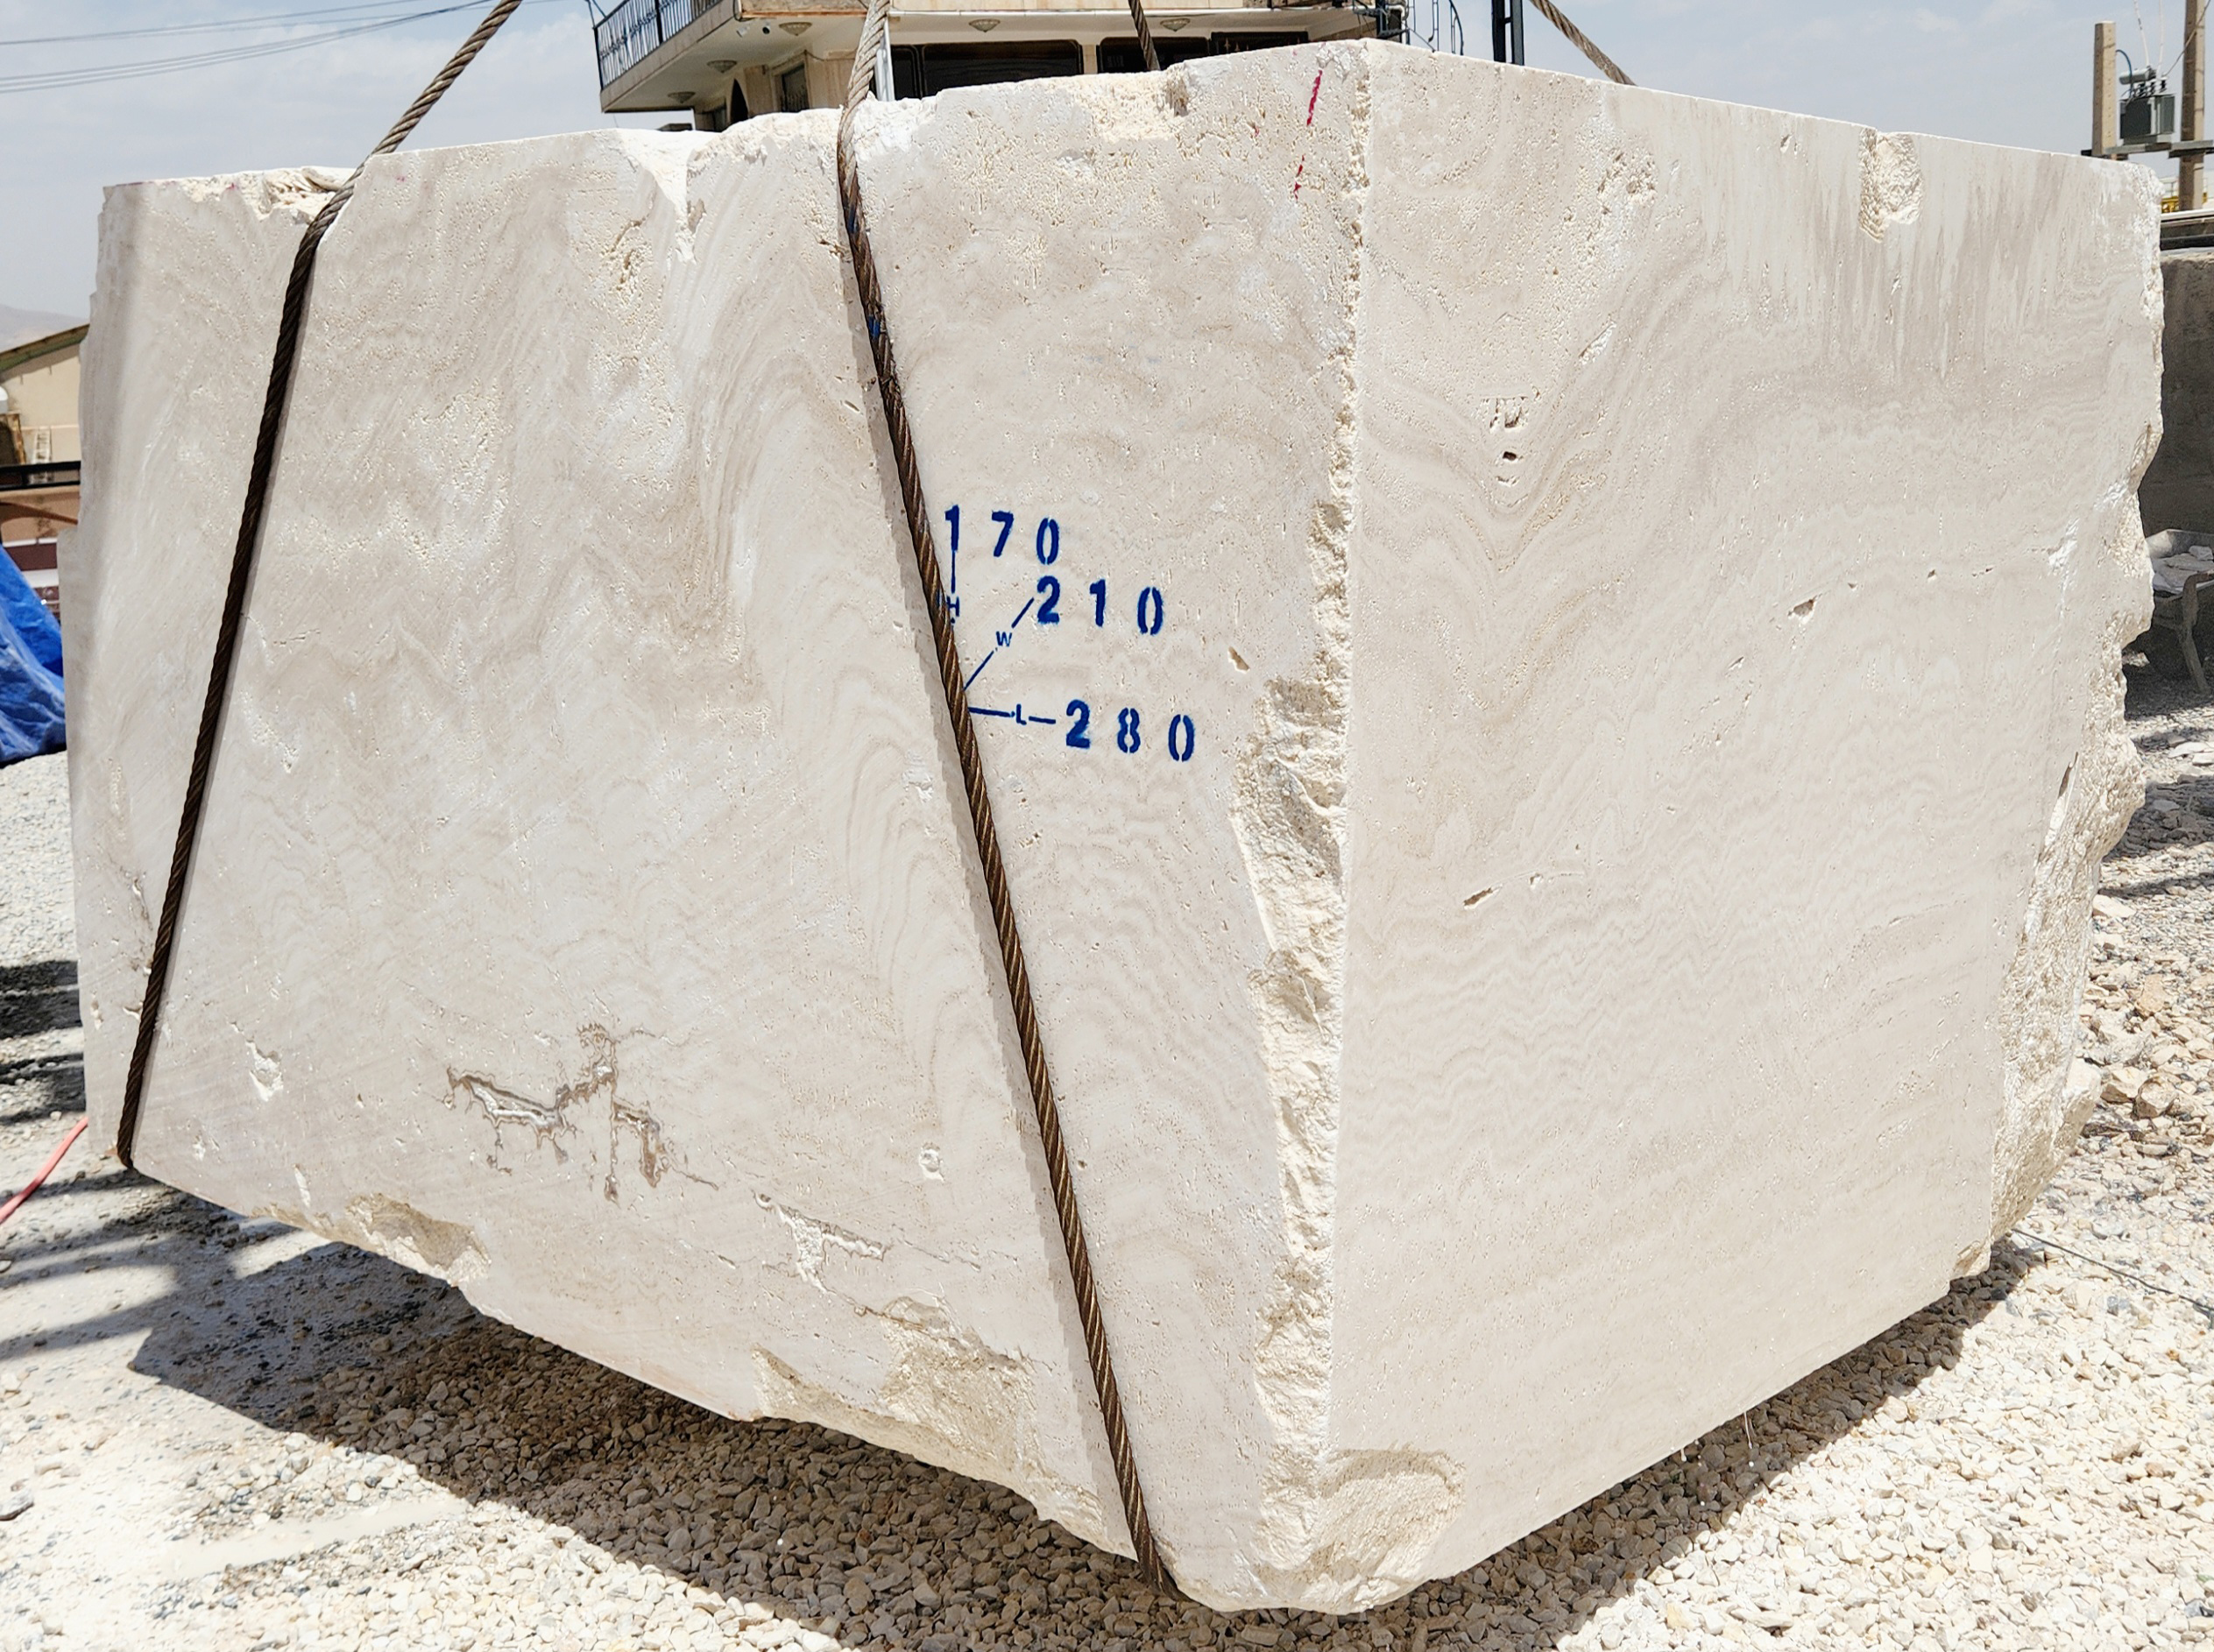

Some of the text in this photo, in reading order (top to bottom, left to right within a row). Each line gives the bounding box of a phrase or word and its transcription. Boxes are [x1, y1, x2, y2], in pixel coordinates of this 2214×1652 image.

[944, 505, 1060, 566] 170
[1036, 575, 1164, 636] 210
[995, 631, 1013, 648] W
[1065, 699, 1197, 763] 280
